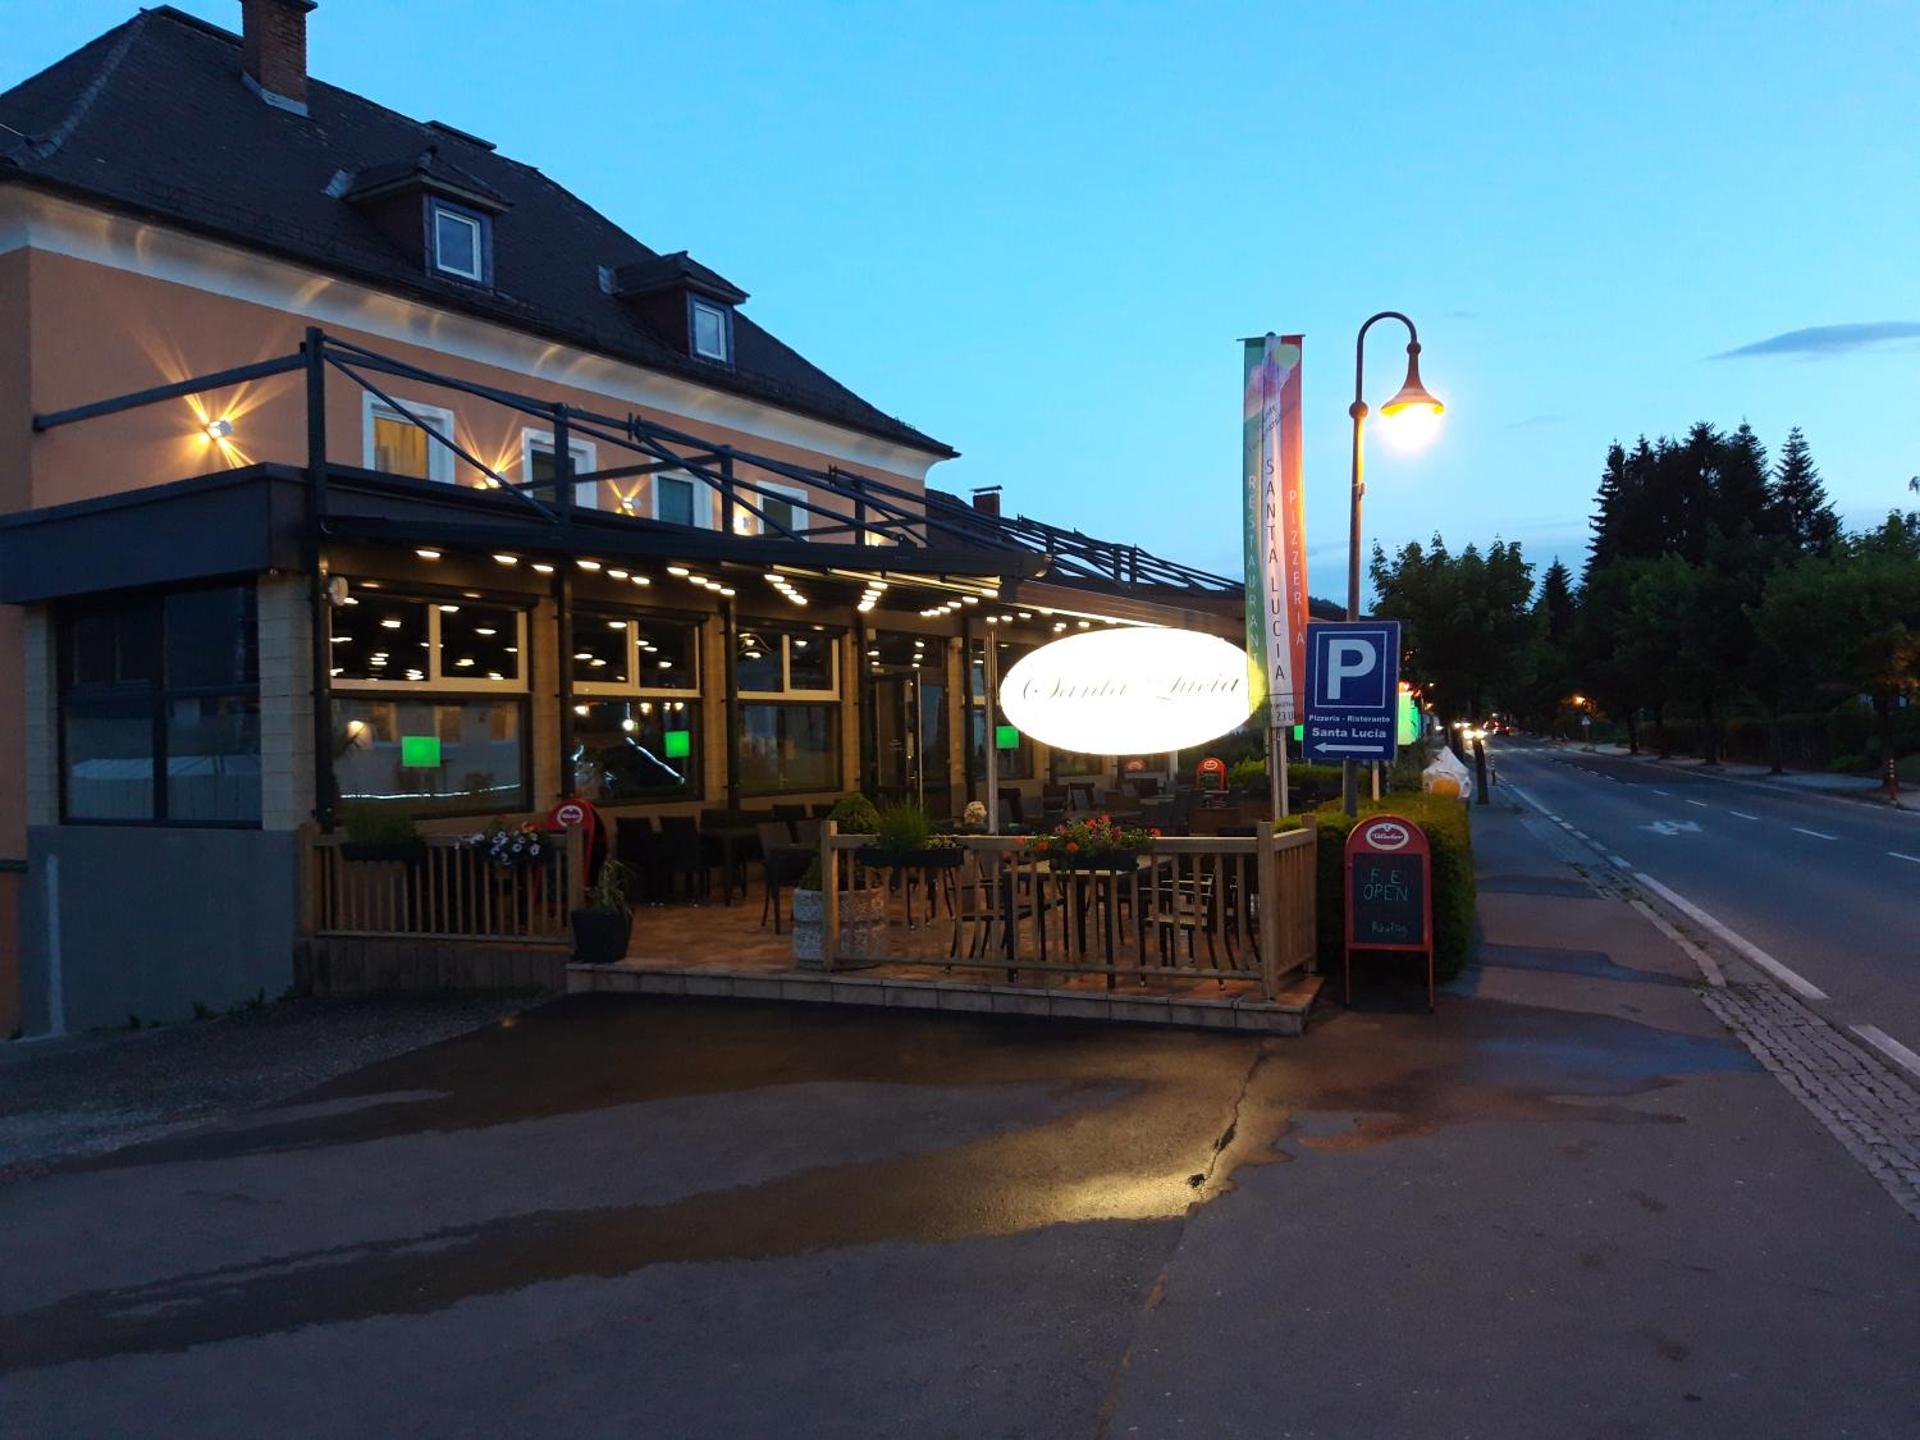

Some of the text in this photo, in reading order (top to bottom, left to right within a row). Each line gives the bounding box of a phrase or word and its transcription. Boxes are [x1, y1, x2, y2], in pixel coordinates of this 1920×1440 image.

[1248, 475, 1260, 663] RESTAURANT
[1266, 459, 1285, 680] SANTA LUCIA
[1289, 490, 1305, 645] PIZZERIA
[1327, 639, 1377, 700] P
[1309, 714, 1340, 722] Pizzeria
[1347, 715, 1391, 723] Ristorante
[1312, 727, 1387, 738] Santa Lucia
[1363, 883, 1408, 901] OPEN
